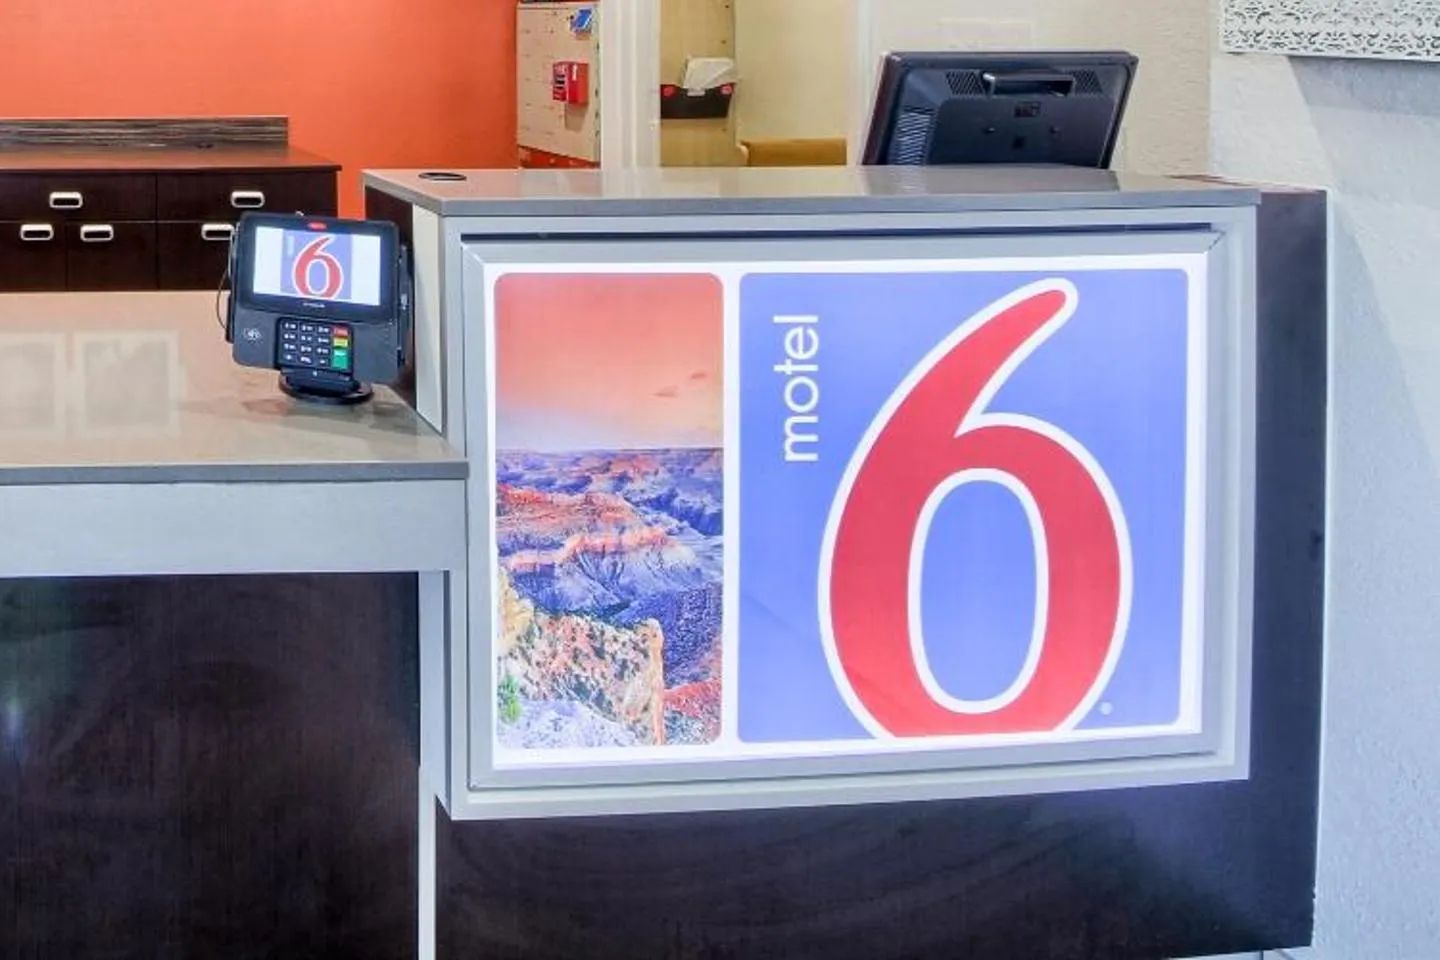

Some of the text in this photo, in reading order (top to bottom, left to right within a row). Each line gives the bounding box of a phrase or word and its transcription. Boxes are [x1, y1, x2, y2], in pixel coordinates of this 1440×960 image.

[291, 234, 344, 299] 6
[772, 277, 1133, 739] motel 6
